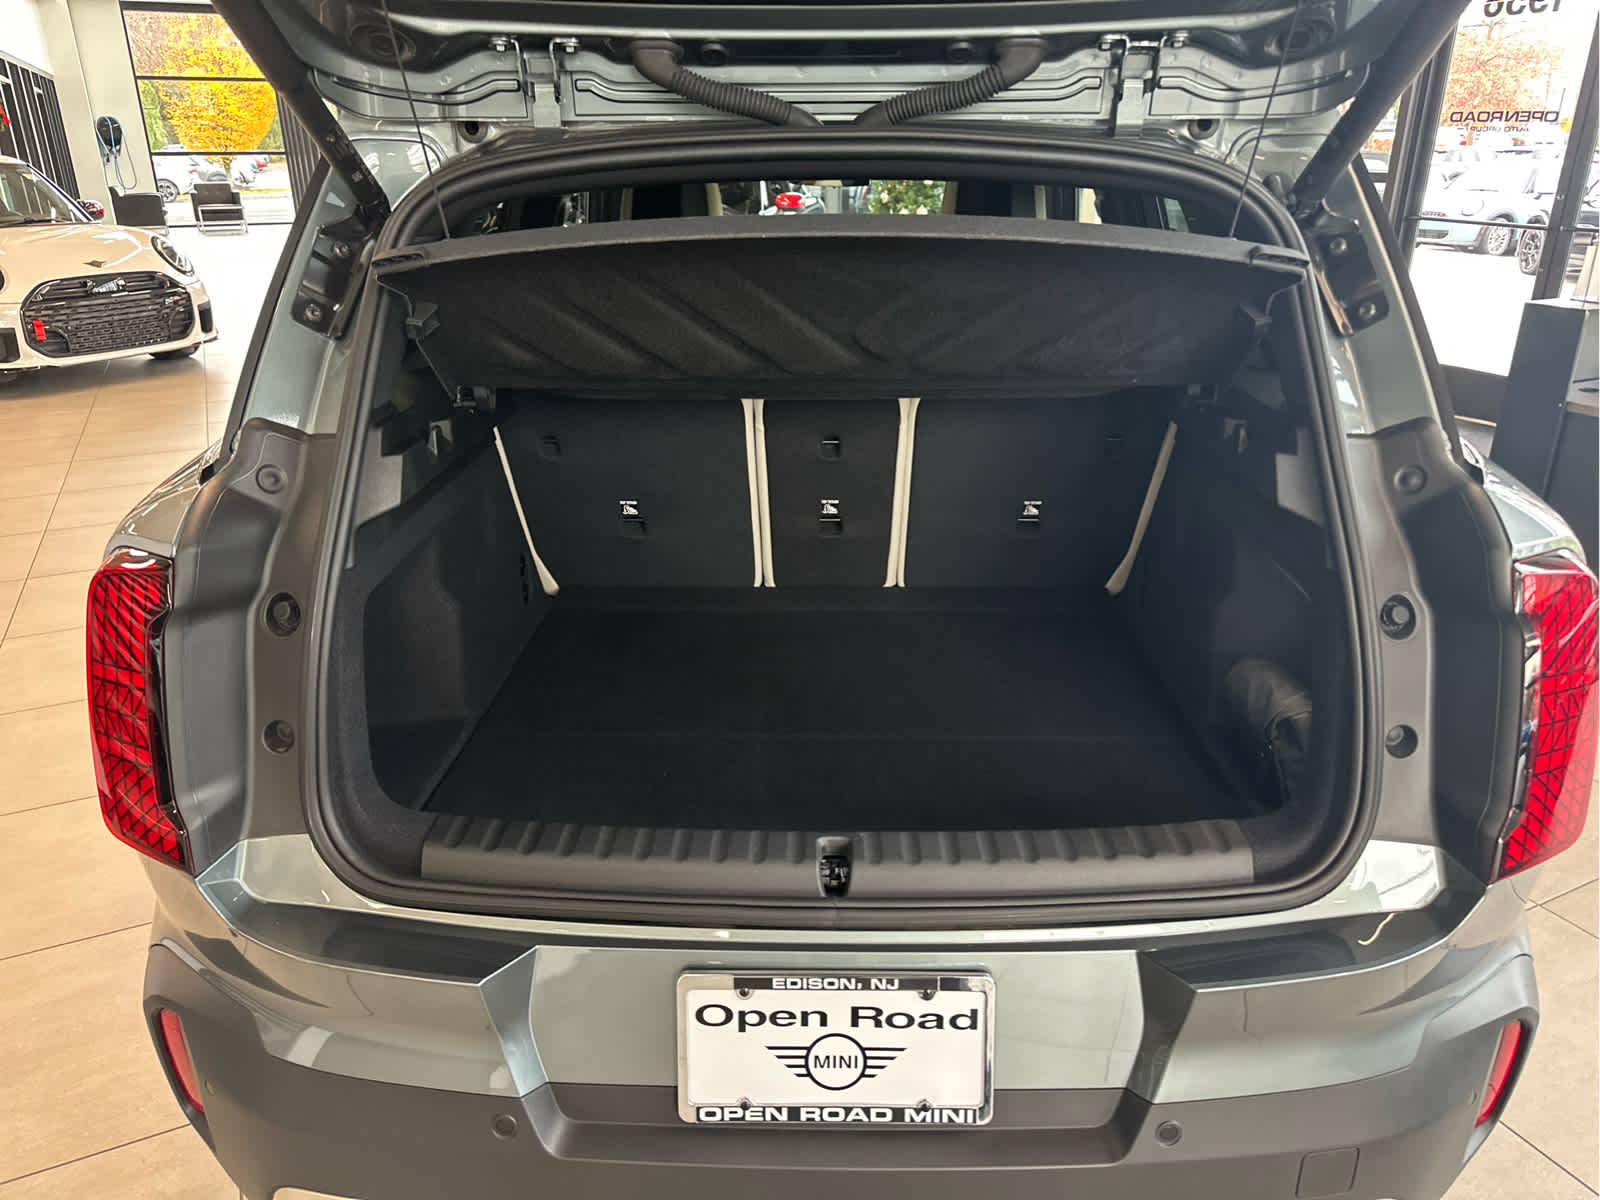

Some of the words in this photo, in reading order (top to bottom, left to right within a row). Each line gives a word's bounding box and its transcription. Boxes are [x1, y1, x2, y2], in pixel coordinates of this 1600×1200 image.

[870, 978, 900, 991] NJ
[695, 1004, 828, 1032] Open
[850, 1005, 979, 1031] Road
[813, 1055, 859, 1069] MINI
[699, 1106, 789, 1122] OPEN
[800, 1106, 893, 1122] ROAD
[904, 1107, 977, 1124] MINI
